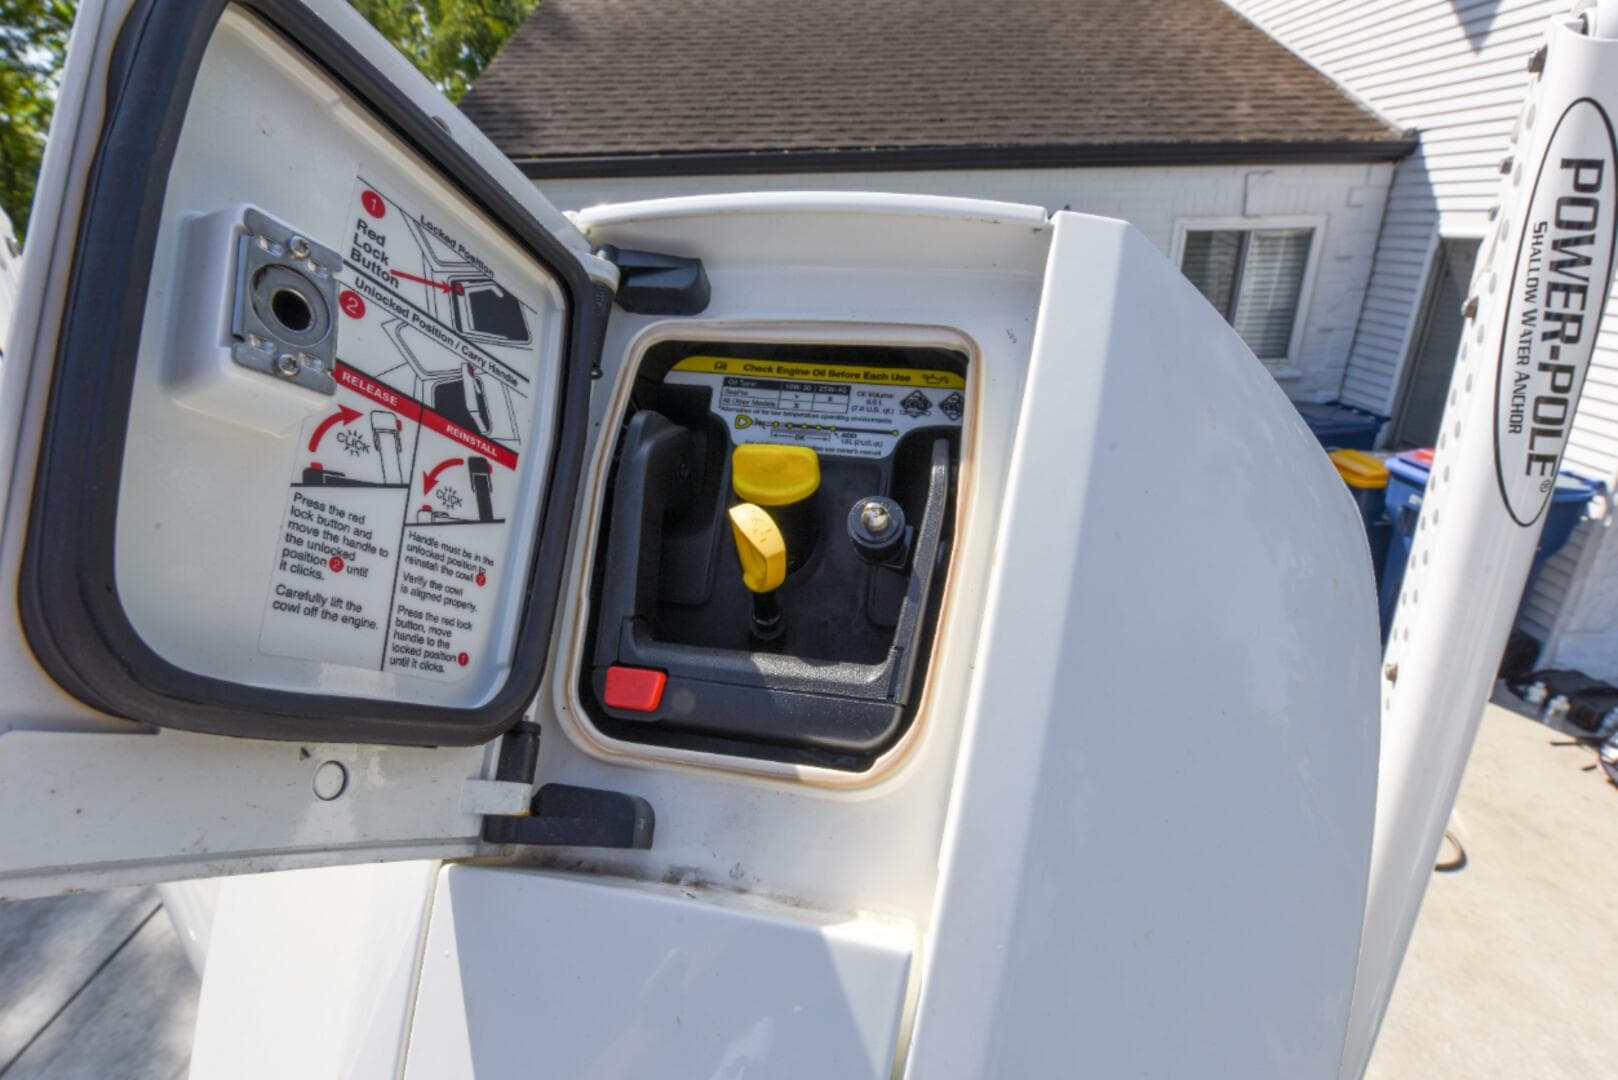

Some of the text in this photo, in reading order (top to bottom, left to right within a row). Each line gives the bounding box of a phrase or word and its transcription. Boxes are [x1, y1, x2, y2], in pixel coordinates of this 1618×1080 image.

[356, 218, 386, 247] Red
[420, 214, 495, 280] Locked Position
[353, 233, 389, 266] Lock
[350, 247, 400, 289] Button
[354, 277, 410, 318] Unlocked
[412, 313, 455, 347] Position
[461, 344, 487, 368] Carry
[488, 360, 520, 387] Handle
[1507, 220, 1548, 434] SHALLOW WATER ANCHOR
[1525, 157, 1605, 477] POWER-POLE
[743, 362, 912, 381] Check Engine Oil Before Each Use
[341, 371, 399, 407] RELEASE
[336, 431, 371, 455] CLICK
[446, 424, 499, 458] REINSTALL
[293, 492, 366, 525] Press the red
[435, 488, 463, 508] CLICK
[290, 505, 373, 541] lock button and
[284, 533, 356, 561] the unlocked
[287, 520, 389, 558] move the handle to
[408, 530, 439, 548] Handle
[441, 542, 461, 555] must
[462, 549, 472, 559] be
[482, 555, 495, 567] the
[279, 560, 325, 581] it clicks.
[282, 547, 328, 568] position
[346, 565, 369, 578] until
[404, 554, 439, 570] reinstall
[440, 564, 454, 576] the
[406, 543, 445, 562] unlocked
[446, 555, 477, 572] position
[275, 583, 363, 613] Carefully lift the
[400, 583, 478, 613] is aligned properly.
[402, 571, 464, 597] Verify the cowl
[272, 599, 379, 630] cowl off the engine.
[394, 617, 452, 638] button, move
[397, 604, 473, 631] Press the red lock
[391, 643, 422, 657] locked
[423, 648, 457, 663] position
[393, 629, 450, 650] handle to the
[389, 655, 410, 667] until
